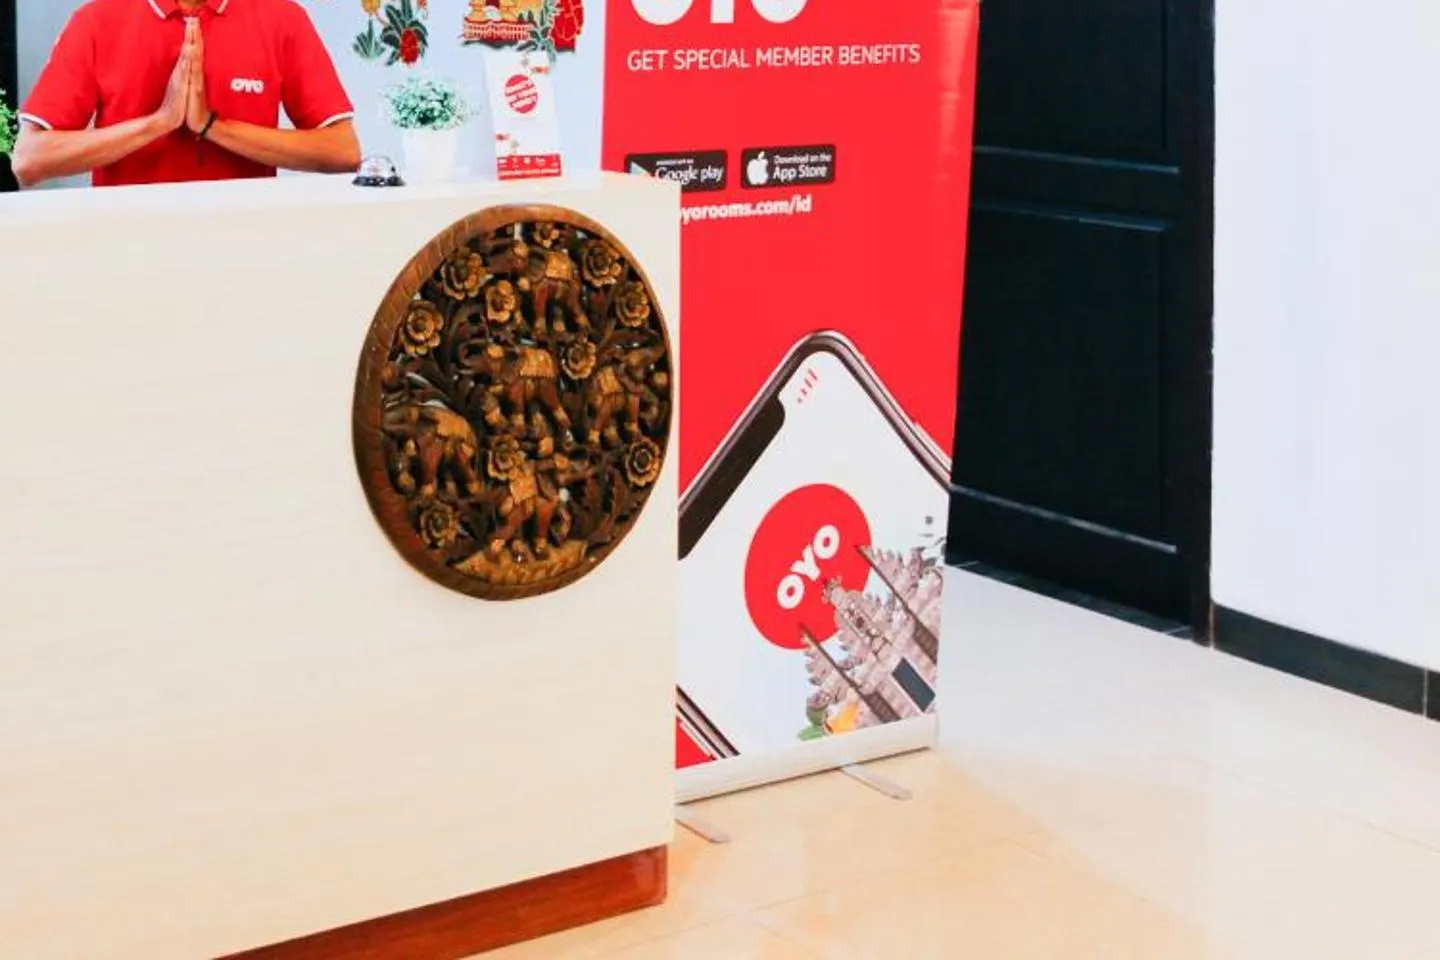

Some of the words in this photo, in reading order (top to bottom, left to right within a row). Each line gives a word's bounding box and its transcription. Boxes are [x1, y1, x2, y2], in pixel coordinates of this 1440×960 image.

[627, 48, 667, 71] GET
[673, 47, 750, 70] SPECIAL
[755, 46, 834, 68] MEMBER
[838, 43, 921, 66] BENEFITS
[230, 77, 265, 94] OYO
[700, 164, 725, 183] play
[772, 166, 798, 182] App
[798, 164, 828, 178] Store
[680, 193, 813, 225] yorooms.com/id
[775, 524, 841, 611] OYO
